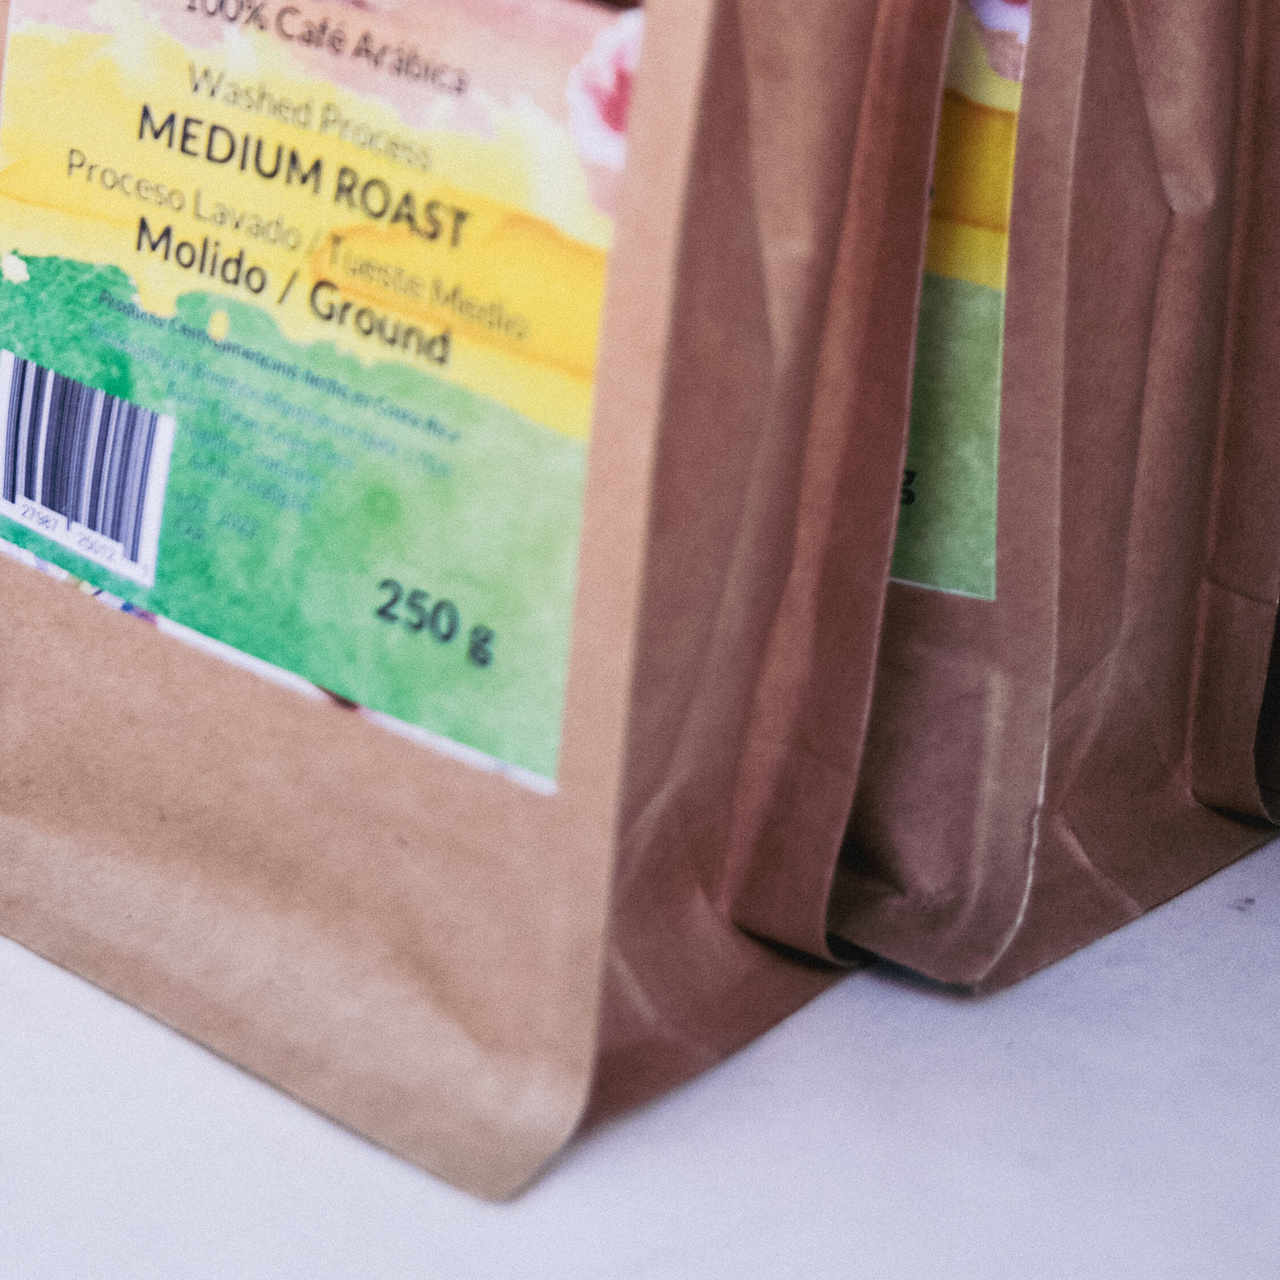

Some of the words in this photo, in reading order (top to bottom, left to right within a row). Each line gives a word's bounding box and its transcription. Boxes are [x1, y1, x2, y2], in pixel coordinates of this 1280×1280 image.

[67, 148, 185, 213] Proceso
[193, 187, 303, 252] Lavado
[138, 103, 322, 196] MEDIUM
[333, 166, 472, 249] ROAST
[136, 215, 269, 295] Molido
[309, 277, 453, 366] Ground
[374, 577, 461, 645] 250
